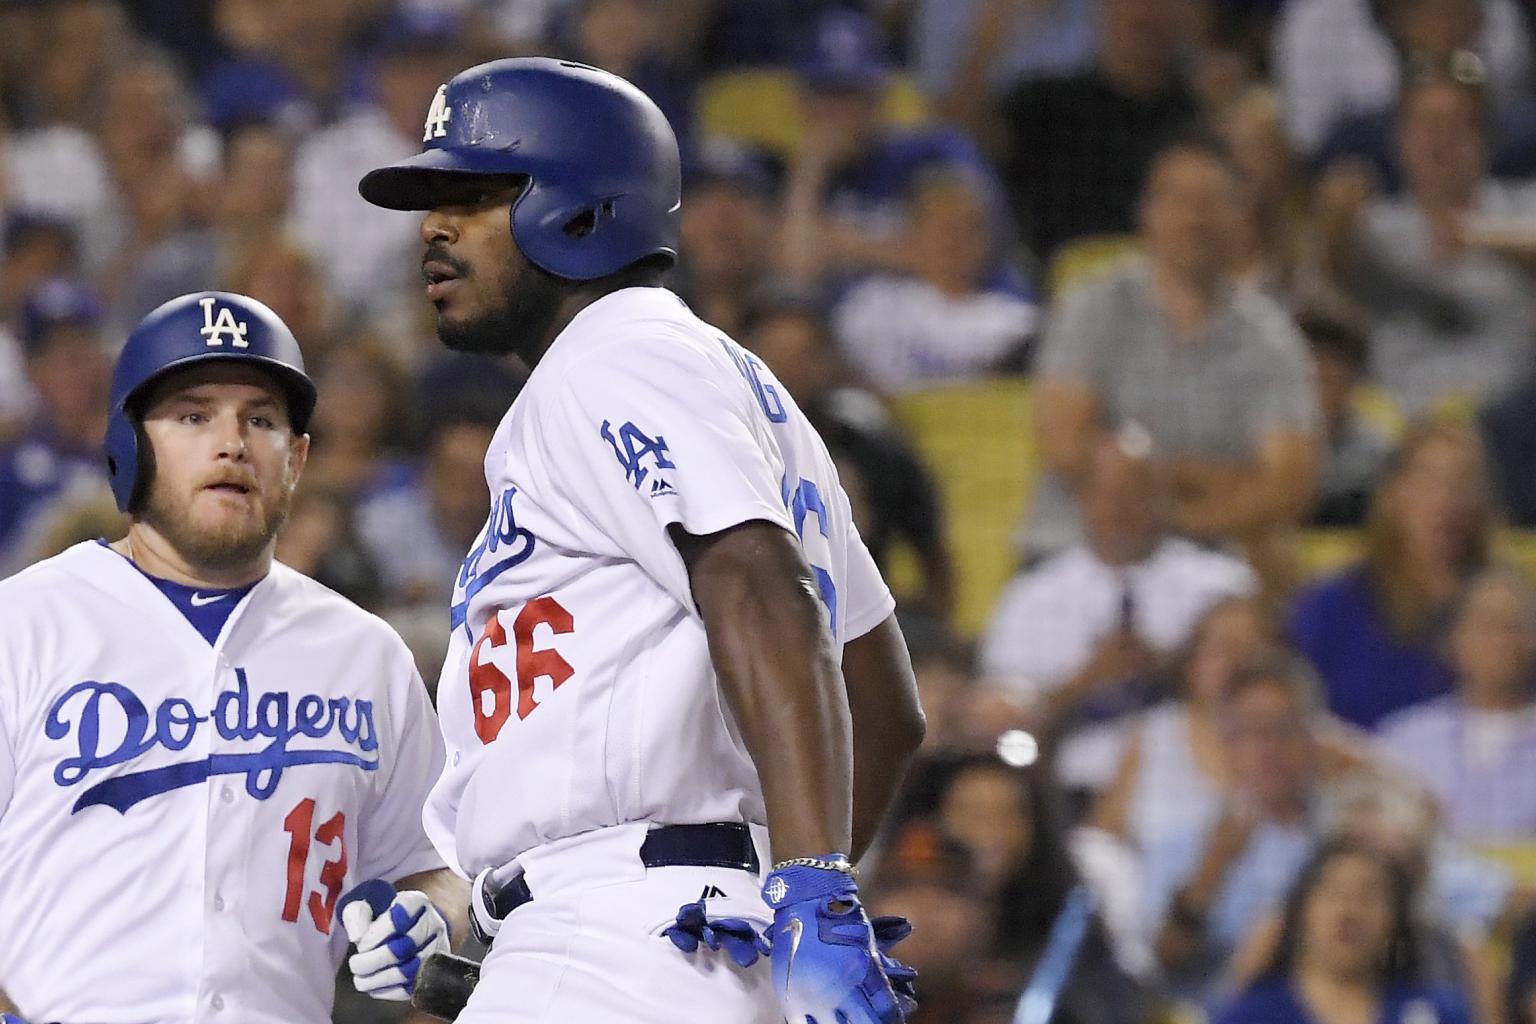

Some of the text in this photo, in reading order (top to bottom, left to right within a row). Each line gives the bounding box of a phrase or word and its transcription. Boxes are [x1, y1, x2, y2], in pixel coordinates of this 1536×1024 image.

[199, 297, 249, 348] LA
[600, 419, 676, 490] LA
[45, 667, 379, 802] Dodgers
[468, 595, 575, 746] 66
[281, 797, 348, 936] 13
